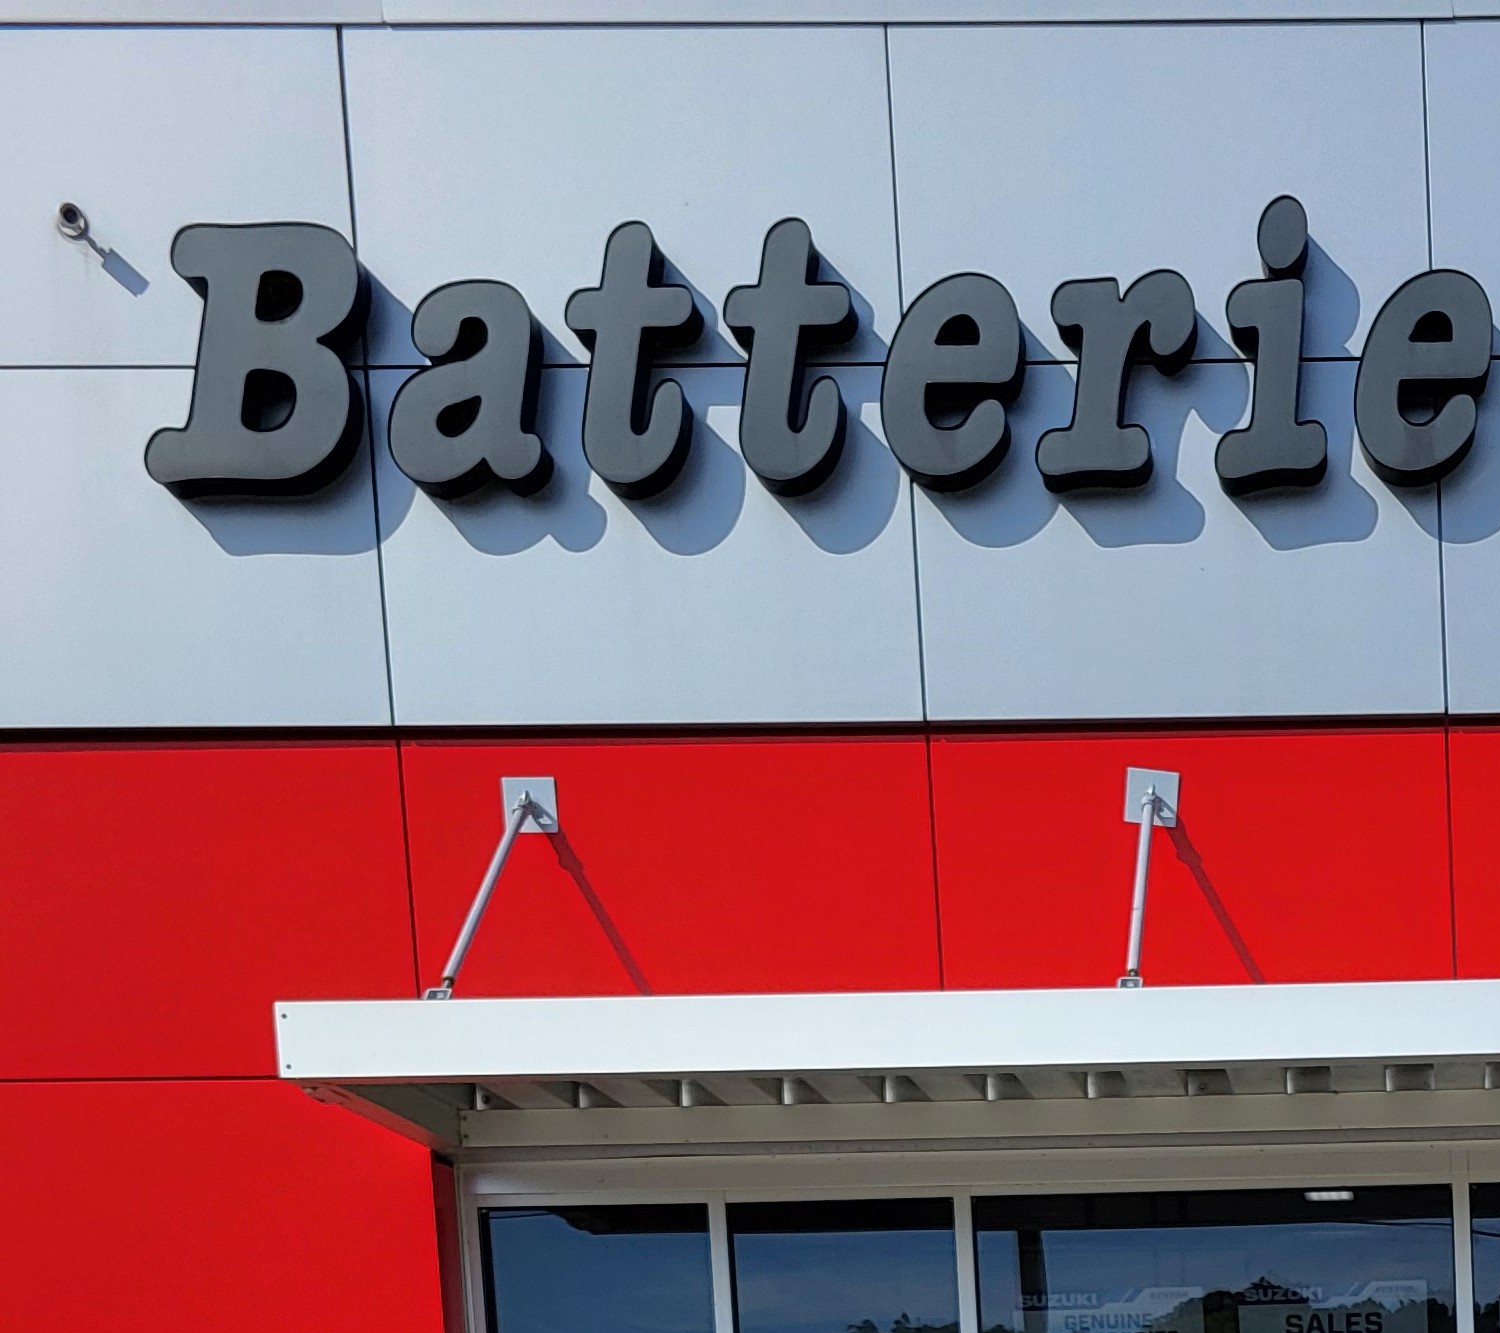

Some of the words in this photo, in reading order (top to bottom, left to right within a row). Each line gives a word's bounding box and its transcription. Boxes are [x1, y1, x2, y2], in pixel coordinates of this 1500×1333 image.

[1016, 1292, 1099, 1308] SUZUKI
[1244, 1286, 1323, 1301] SUZUKI
[1064, 1313, 1154, 1331] GENUINE
